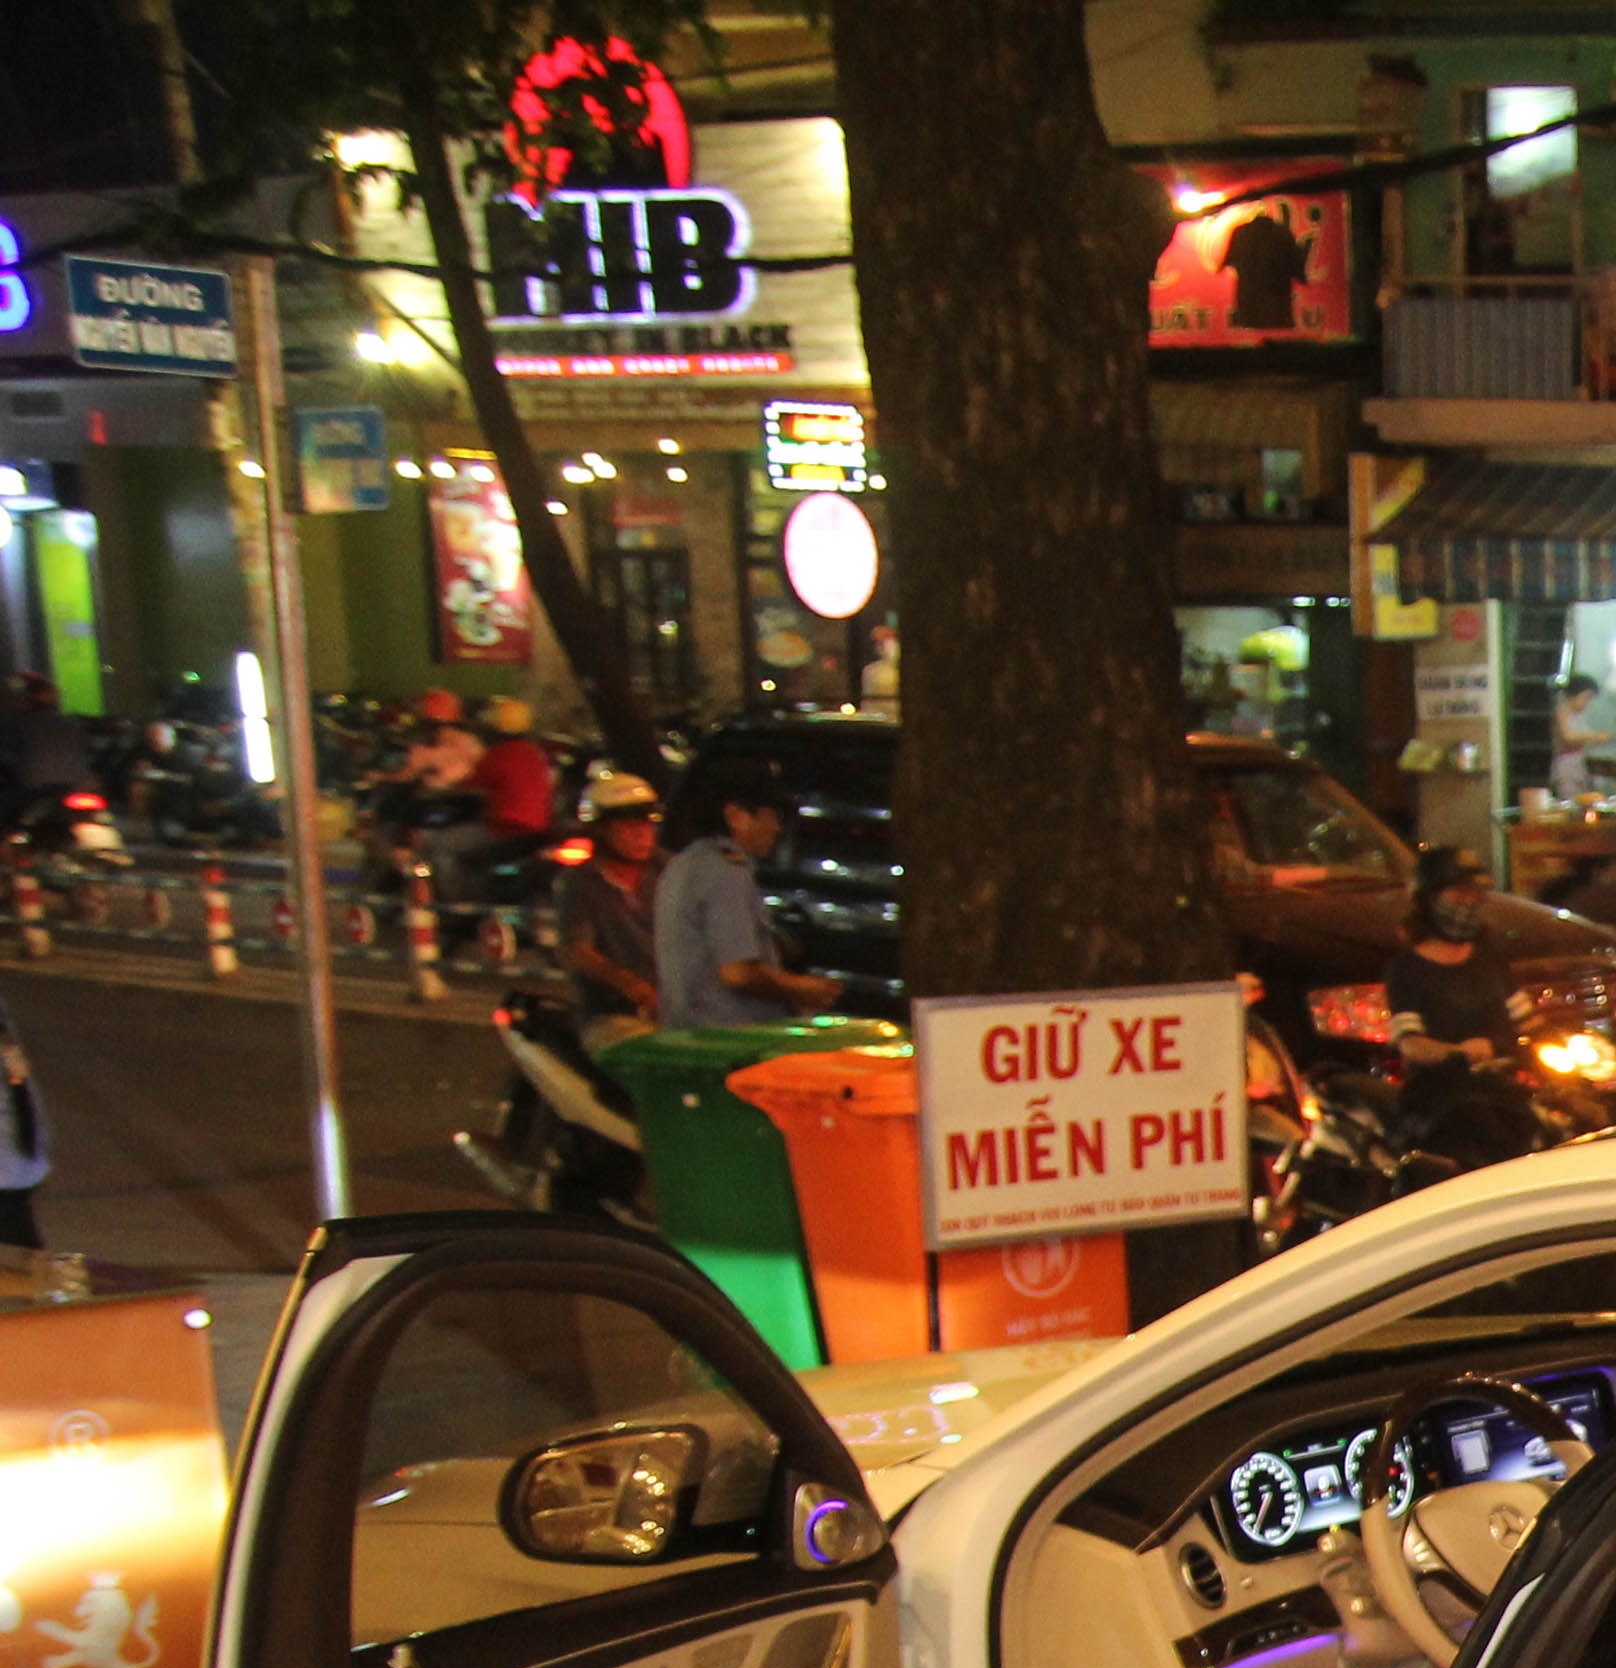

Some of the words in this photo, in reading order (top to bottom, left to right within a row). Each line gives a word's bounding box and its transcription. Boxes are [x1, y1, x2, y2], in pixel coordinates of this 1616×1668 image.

[982, 1006, 1087, 1085] GIỮ
[1108, 1015, 1184, 1075] XE
[947, 1094, 1106, 1192] MIỄN
[1130, 1091, 1228, 1171] PHÍ
